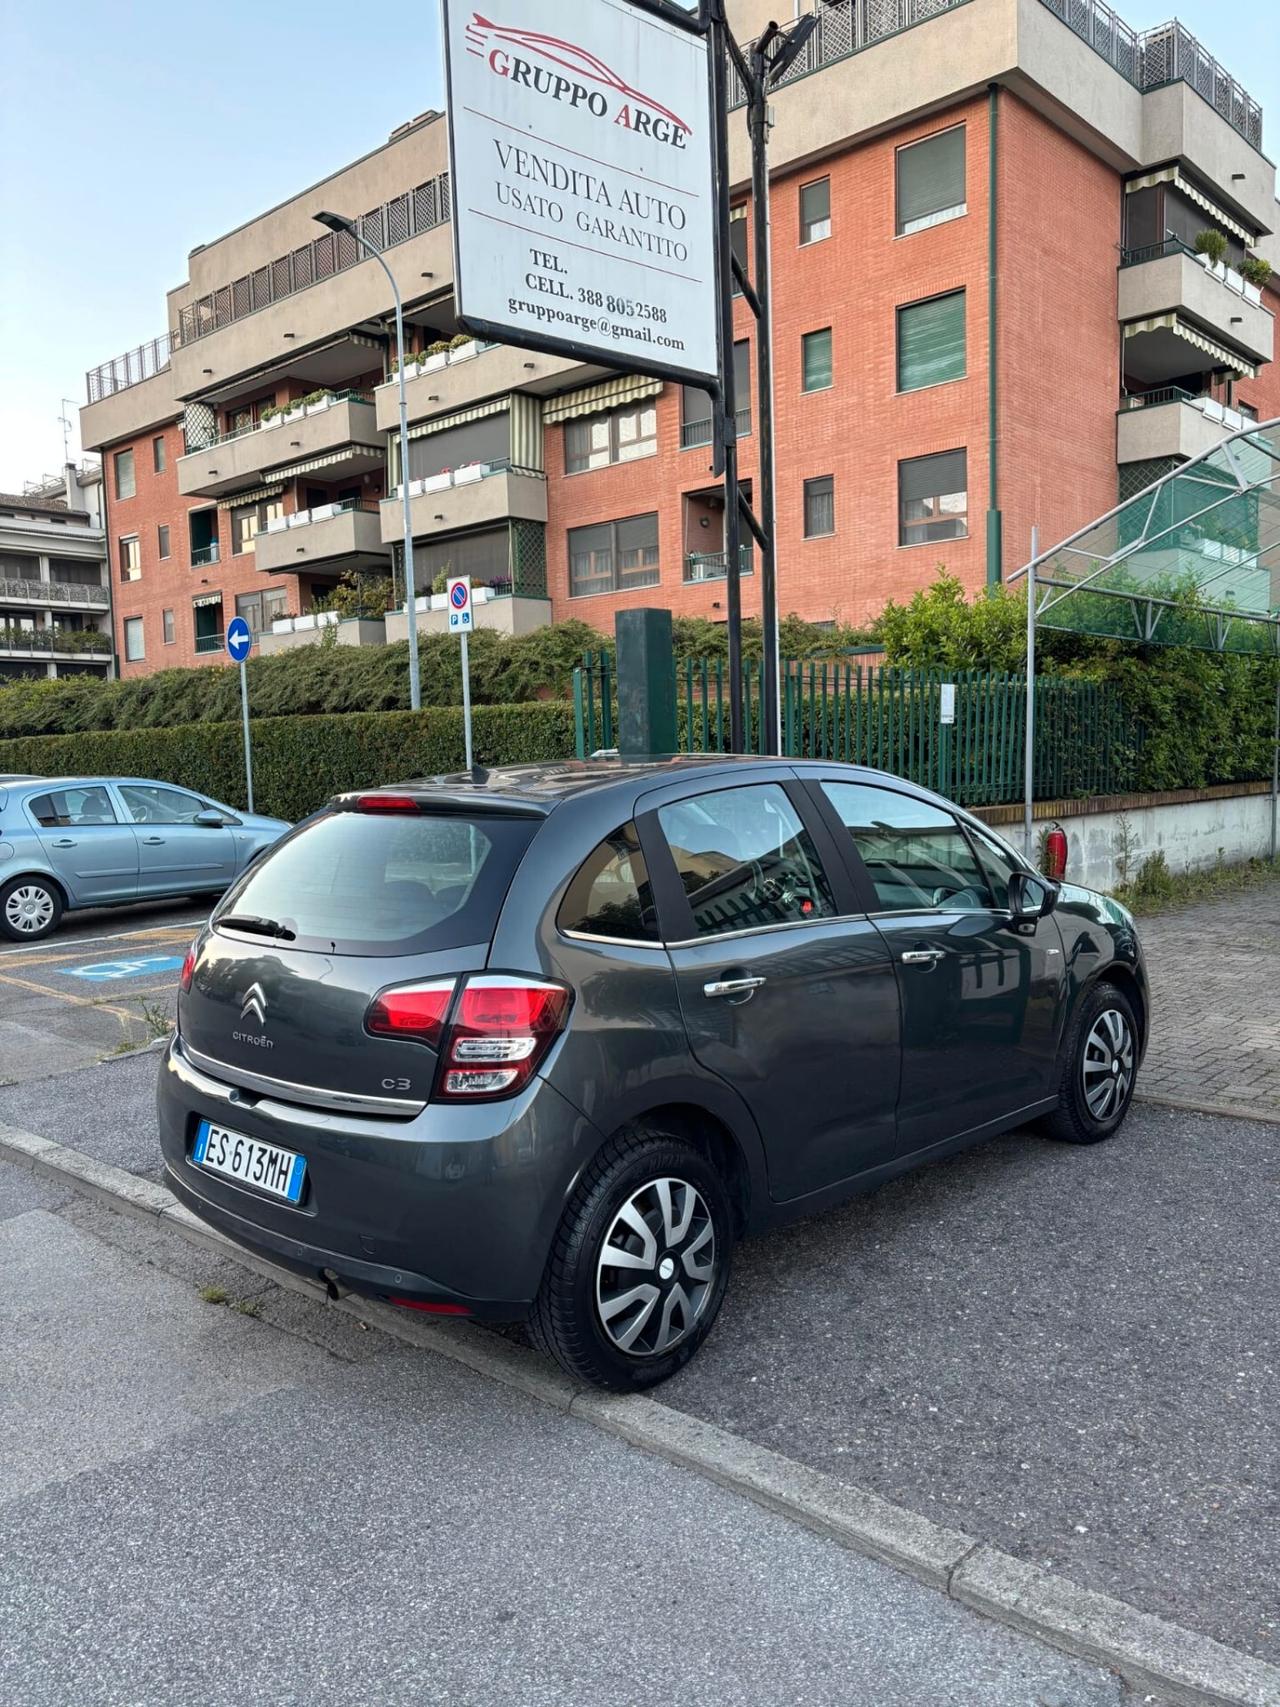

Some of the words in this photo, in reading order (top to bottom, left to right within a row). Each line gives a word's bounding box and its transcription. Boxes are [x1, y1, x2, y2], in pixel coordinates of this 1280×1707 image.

[488, 48, 608, 117] GRUPPO
[614, 104, 687, 149] ARGE
[493, 138, 612, 207] VENDITA
[618, 189, 686, 230] AUTO
[495, 181, 564, 223] USATO
[576, 211, 688, 262] GARANTITO
[529, 248, 568, 274] TEL.
[508, 297, 685, 350] gruppoarge@gmail.com
[525, 273, 574, 300] CELL.
[578, 287, 604, 308] 388
[606, 295, 667, 323] 8052588
[381, 1077, 412, 1090] C3
